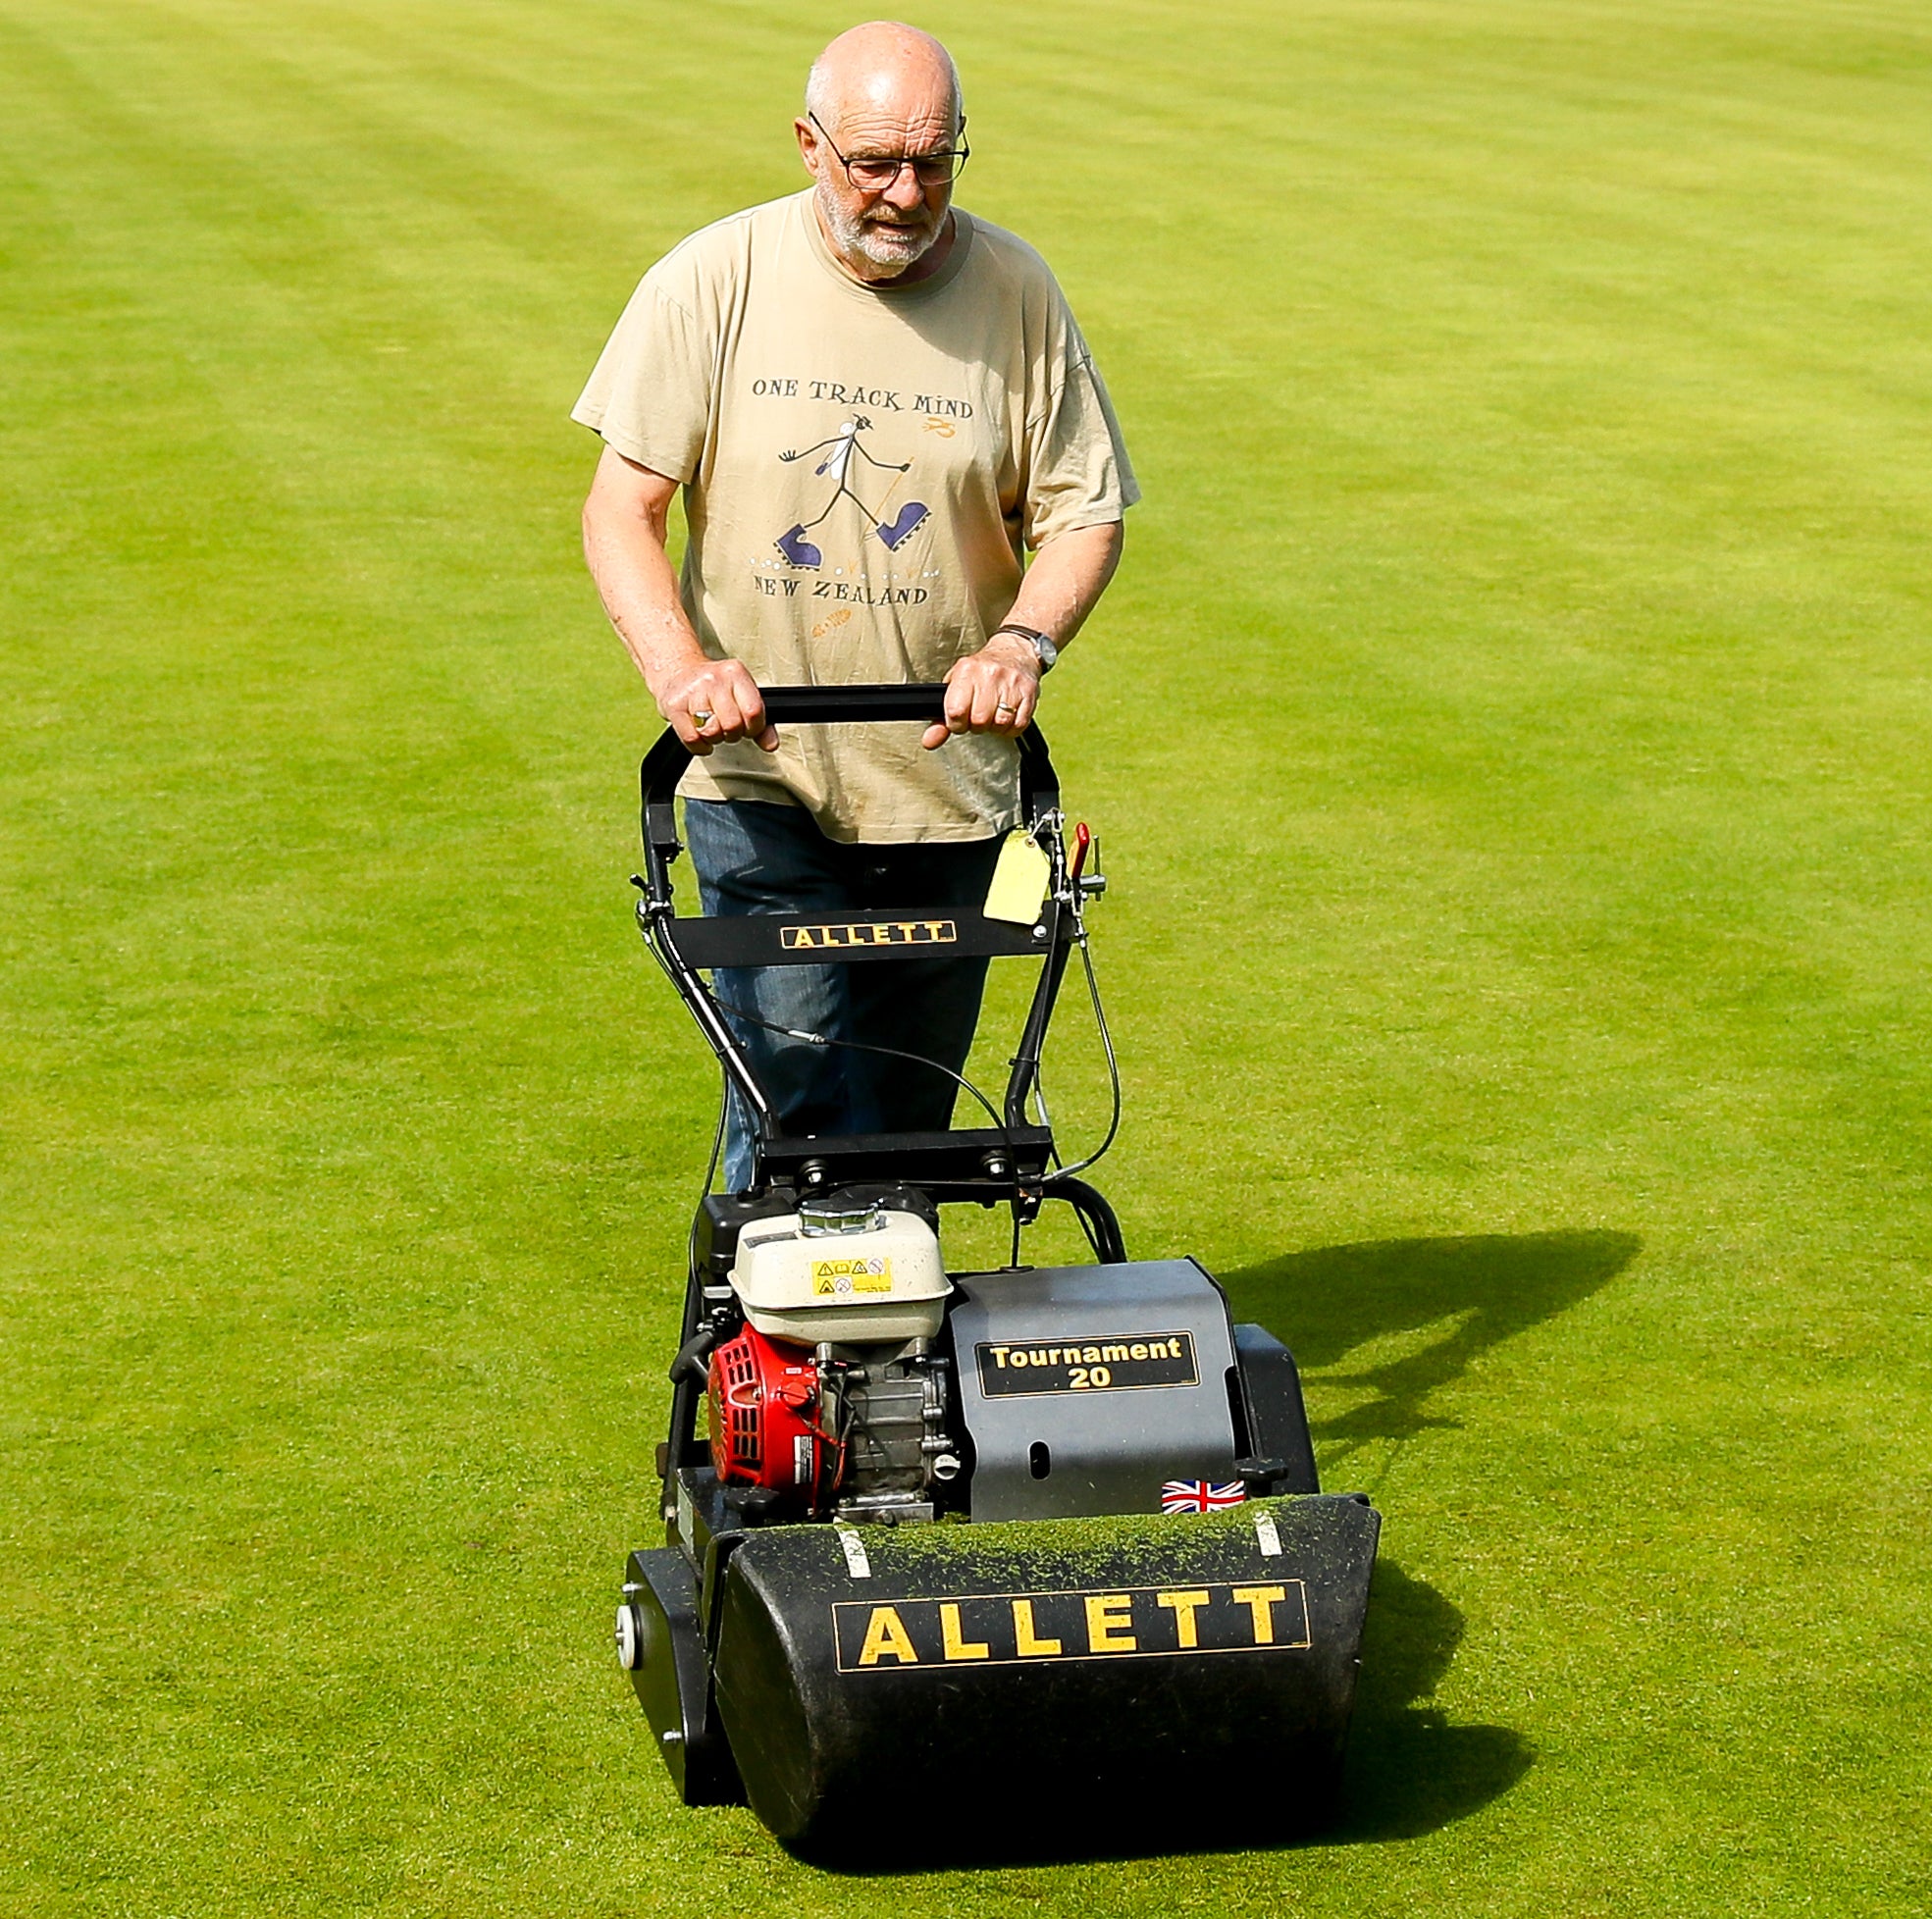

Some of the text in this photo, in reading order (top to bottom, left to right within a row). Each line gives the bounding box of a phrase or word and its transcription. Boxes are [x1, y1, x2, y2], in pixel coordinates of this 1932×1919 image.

[752, 378, 797, 395] ONE
[809, 381, 902, 411] TRACK
[753, 576, 928, 605] NEW ZEALAND
[794, 923, 943, 948] ALLETT
[990, 1337, 1181, 1369] Tournament
[1068, 1367, 1111, 1388] 20
[859, 1586, 1285, 1666] ALLETT
